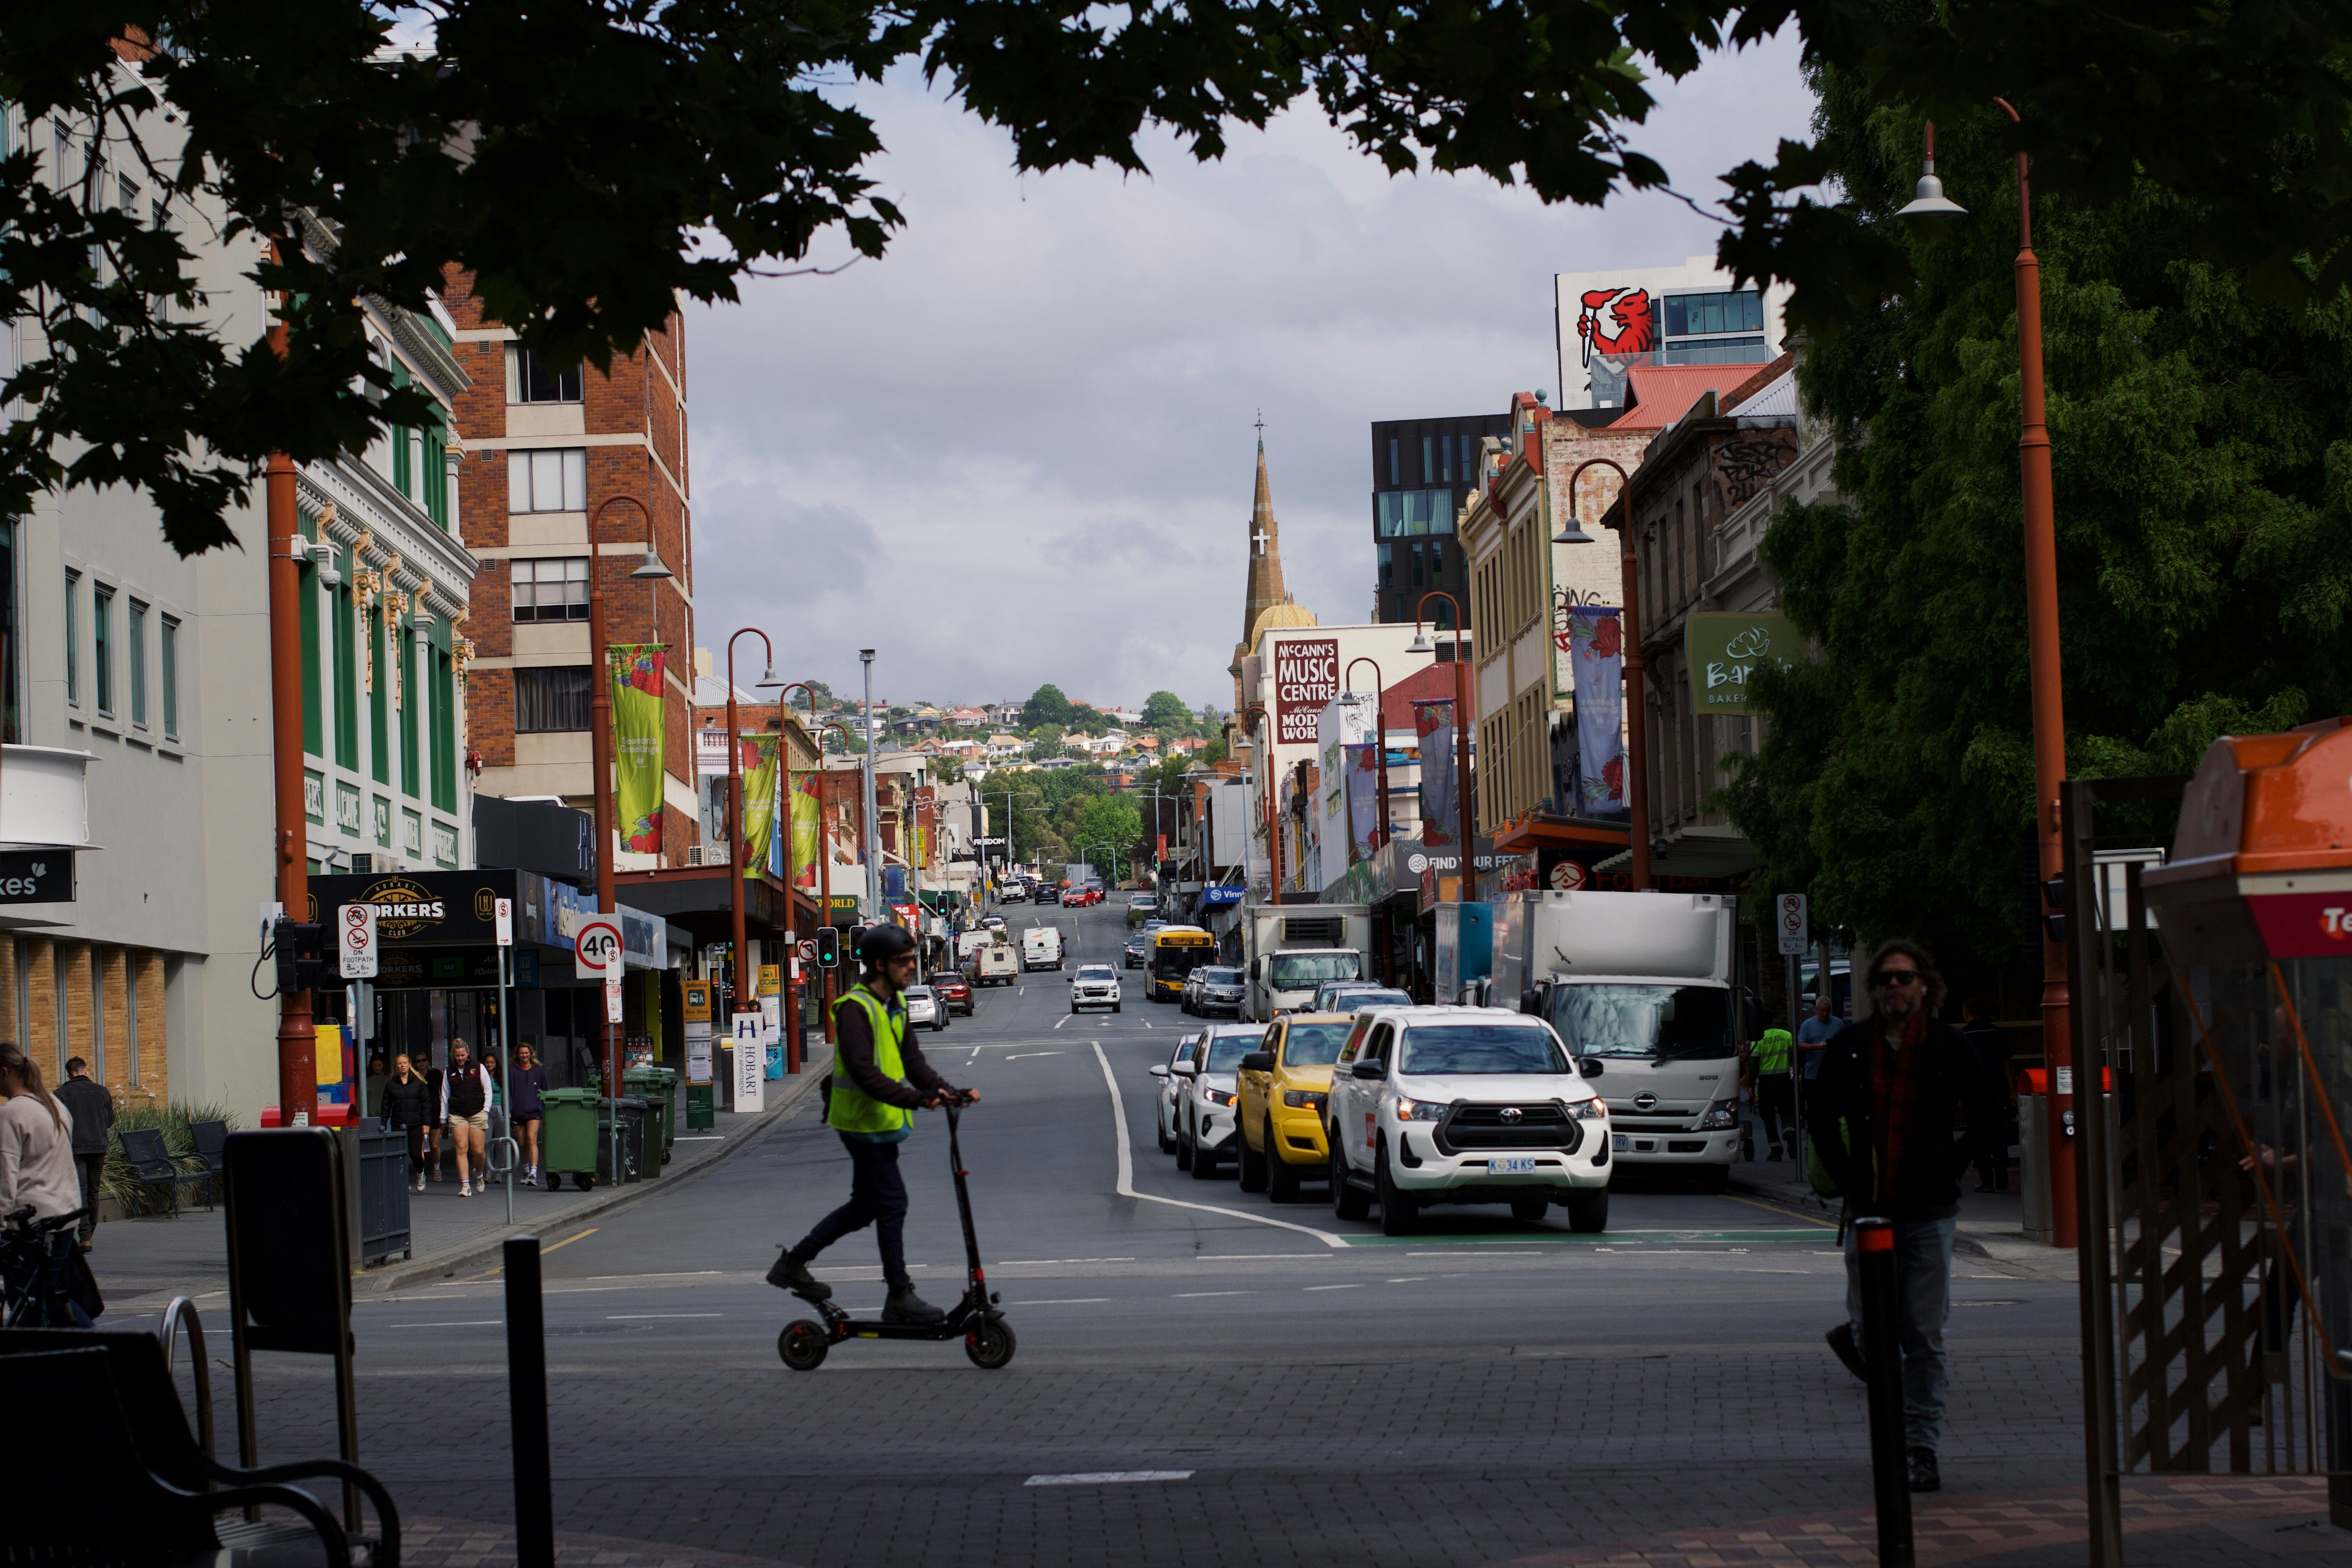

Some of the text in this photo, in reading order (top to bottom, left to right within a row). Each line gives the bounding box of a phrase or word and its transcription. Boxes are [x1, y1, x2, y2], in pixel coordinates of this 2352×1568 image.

[1278, 643, 1335, 658] McCANN'S
[1279, 657, 1336, 684] MUSIC
[1281, 683, 1336, 702] CENTRE
[1709, 694, 1747, 704] BAKER
[1289, 706, 1325, 714] McCann'
[1282, 714, 1318, 727] MOD
[1282, 727, 1318, 740] WOR
[622, 736, 657, 745] Season's
[620, 745, 660, 755] Greetings
[1429, 857, 1457, 869] FIND
[376, 882, 416, 892] HOBART
[1224, 890, 1245, 898] Vinni
[583, 935, 615, 956] 40
[745, 1046, 756, 1097] HOBART
[1490, 1159, 1534, 1171] K 34 KS
